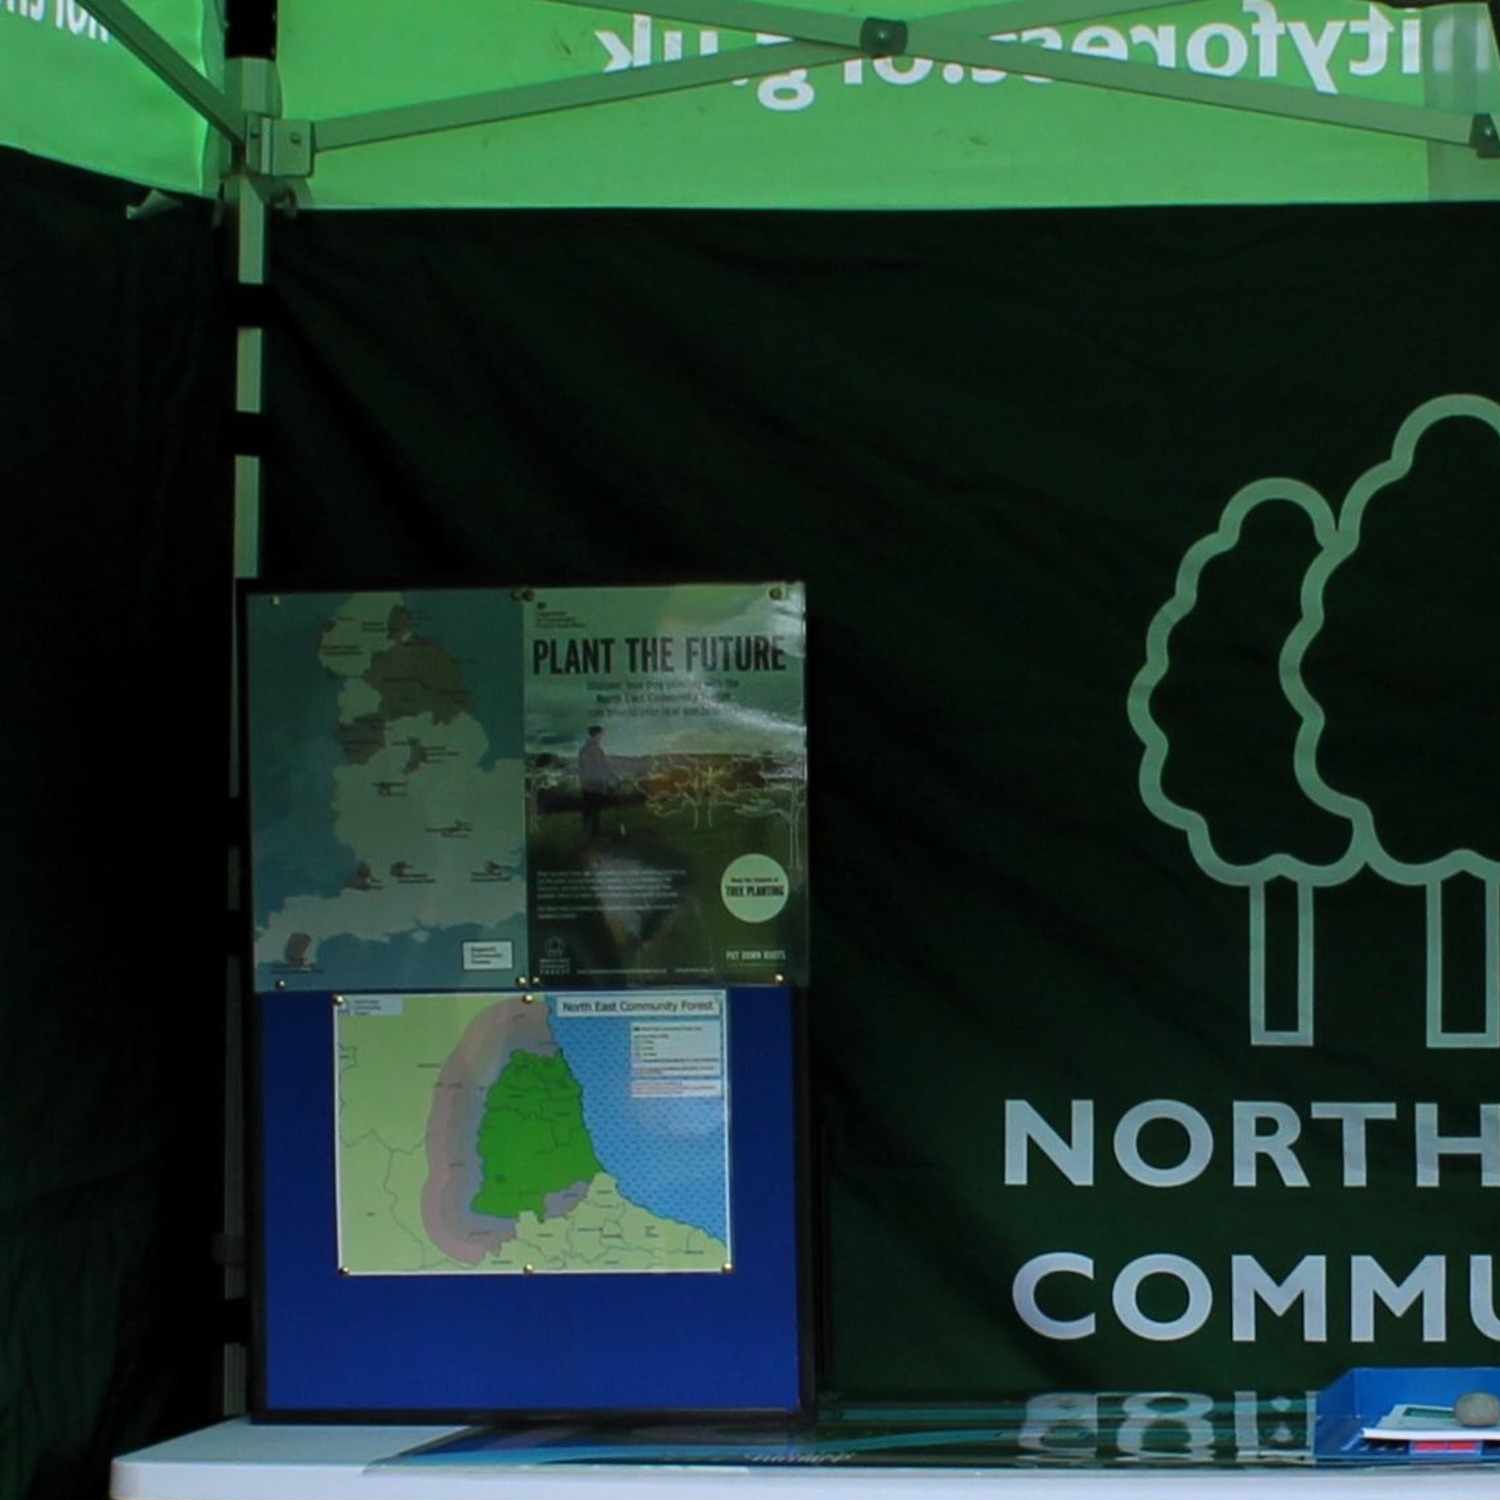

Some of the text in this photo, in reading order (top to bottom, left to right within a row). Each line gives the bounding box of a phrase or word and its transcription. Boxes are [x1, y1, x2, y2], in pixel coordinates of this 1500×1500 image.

[533, 635, 787, 675] PLANT THE FUTURE
[562, 1000, 713, 1014] North East Community Forest
